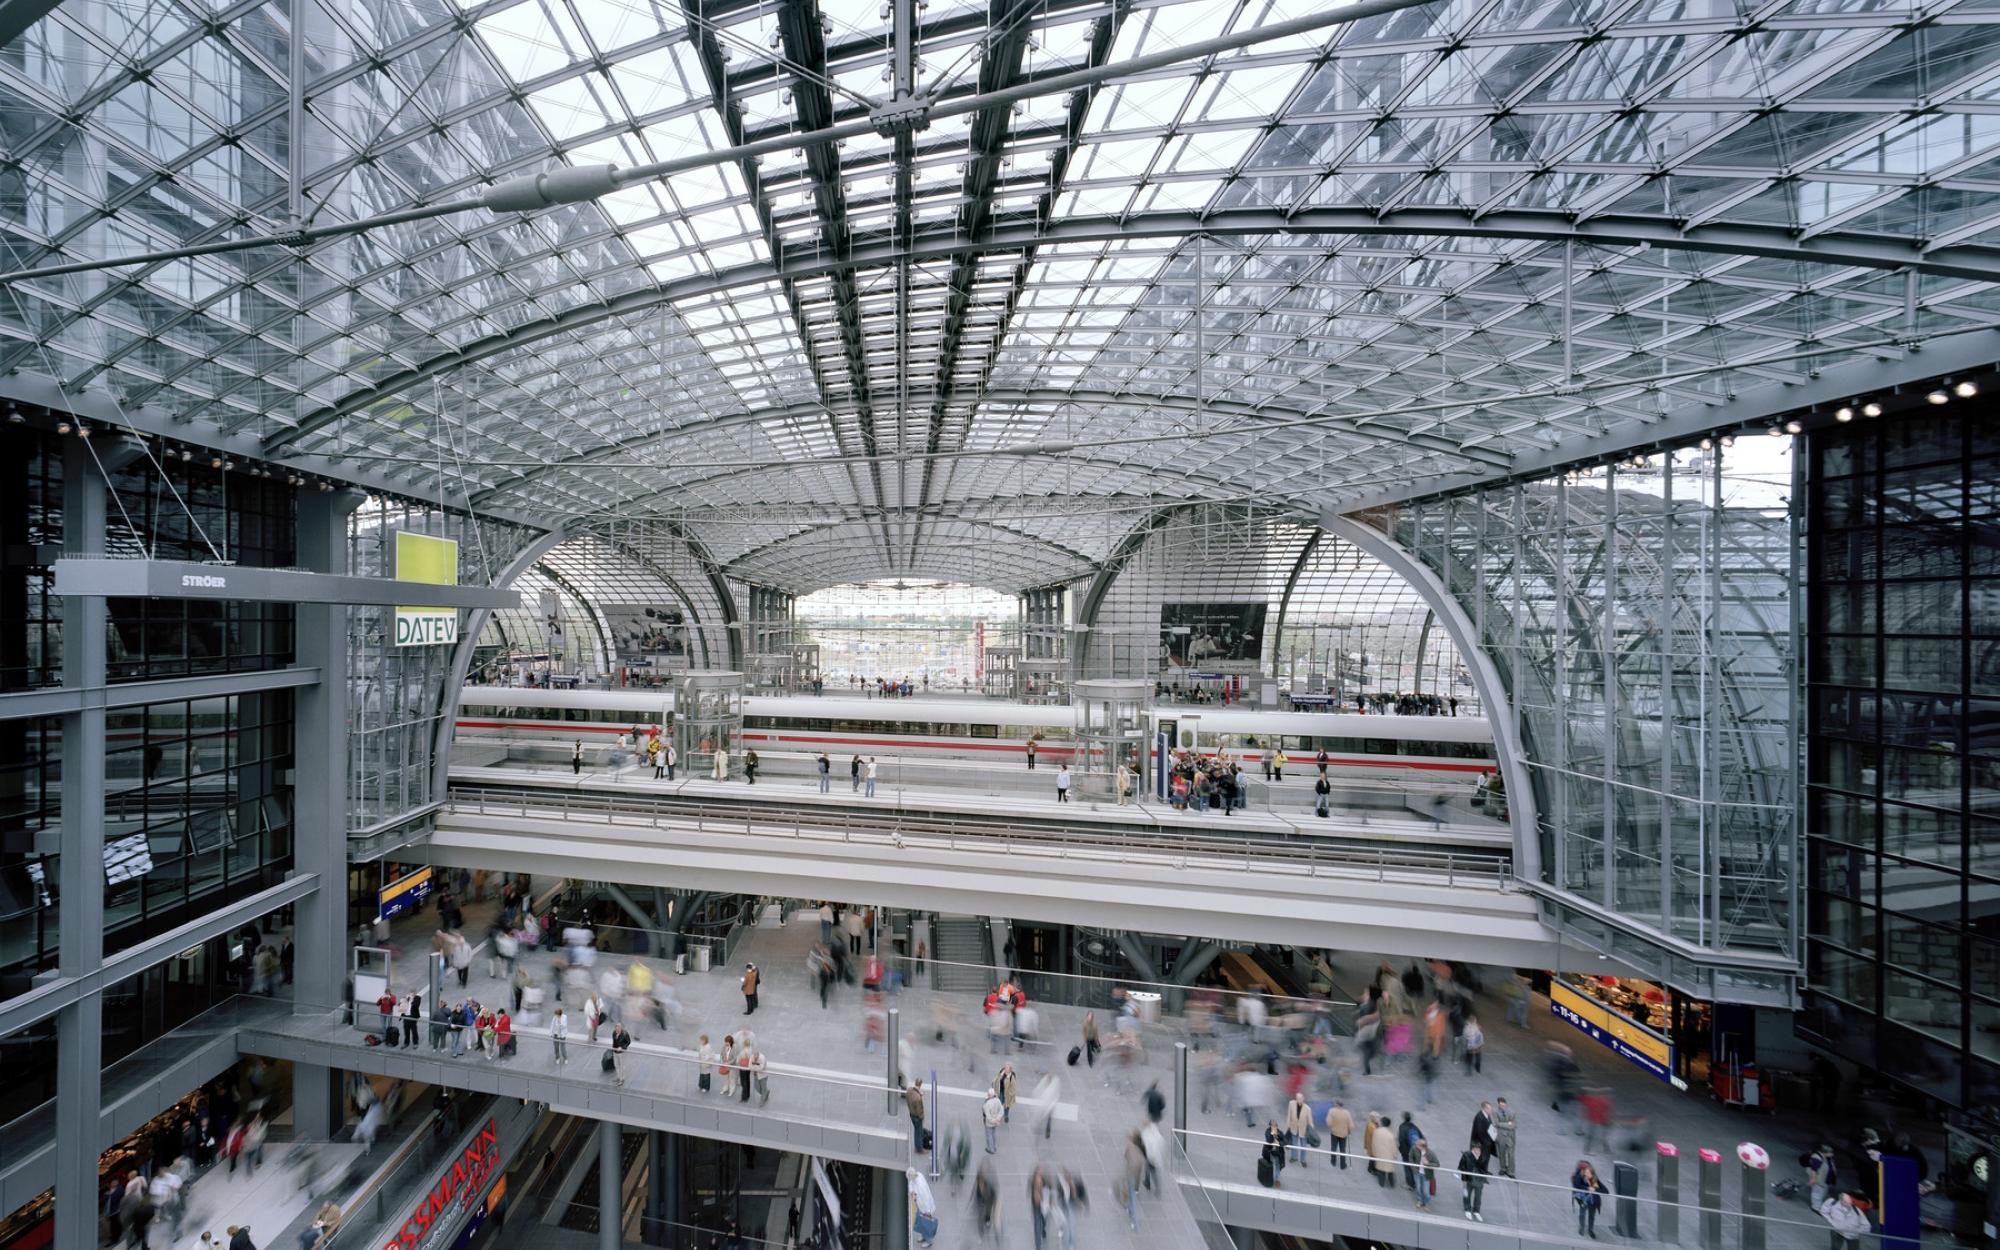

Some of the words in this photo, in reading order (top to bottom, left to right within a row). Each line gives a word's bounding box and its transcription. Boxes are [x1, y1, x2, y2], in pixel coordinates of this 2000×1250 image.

[182, 575, 226, 587] STRÖER
[397, 617, 456, 643] DATEV
[382, 1119, 497, 1250] SSMANN
